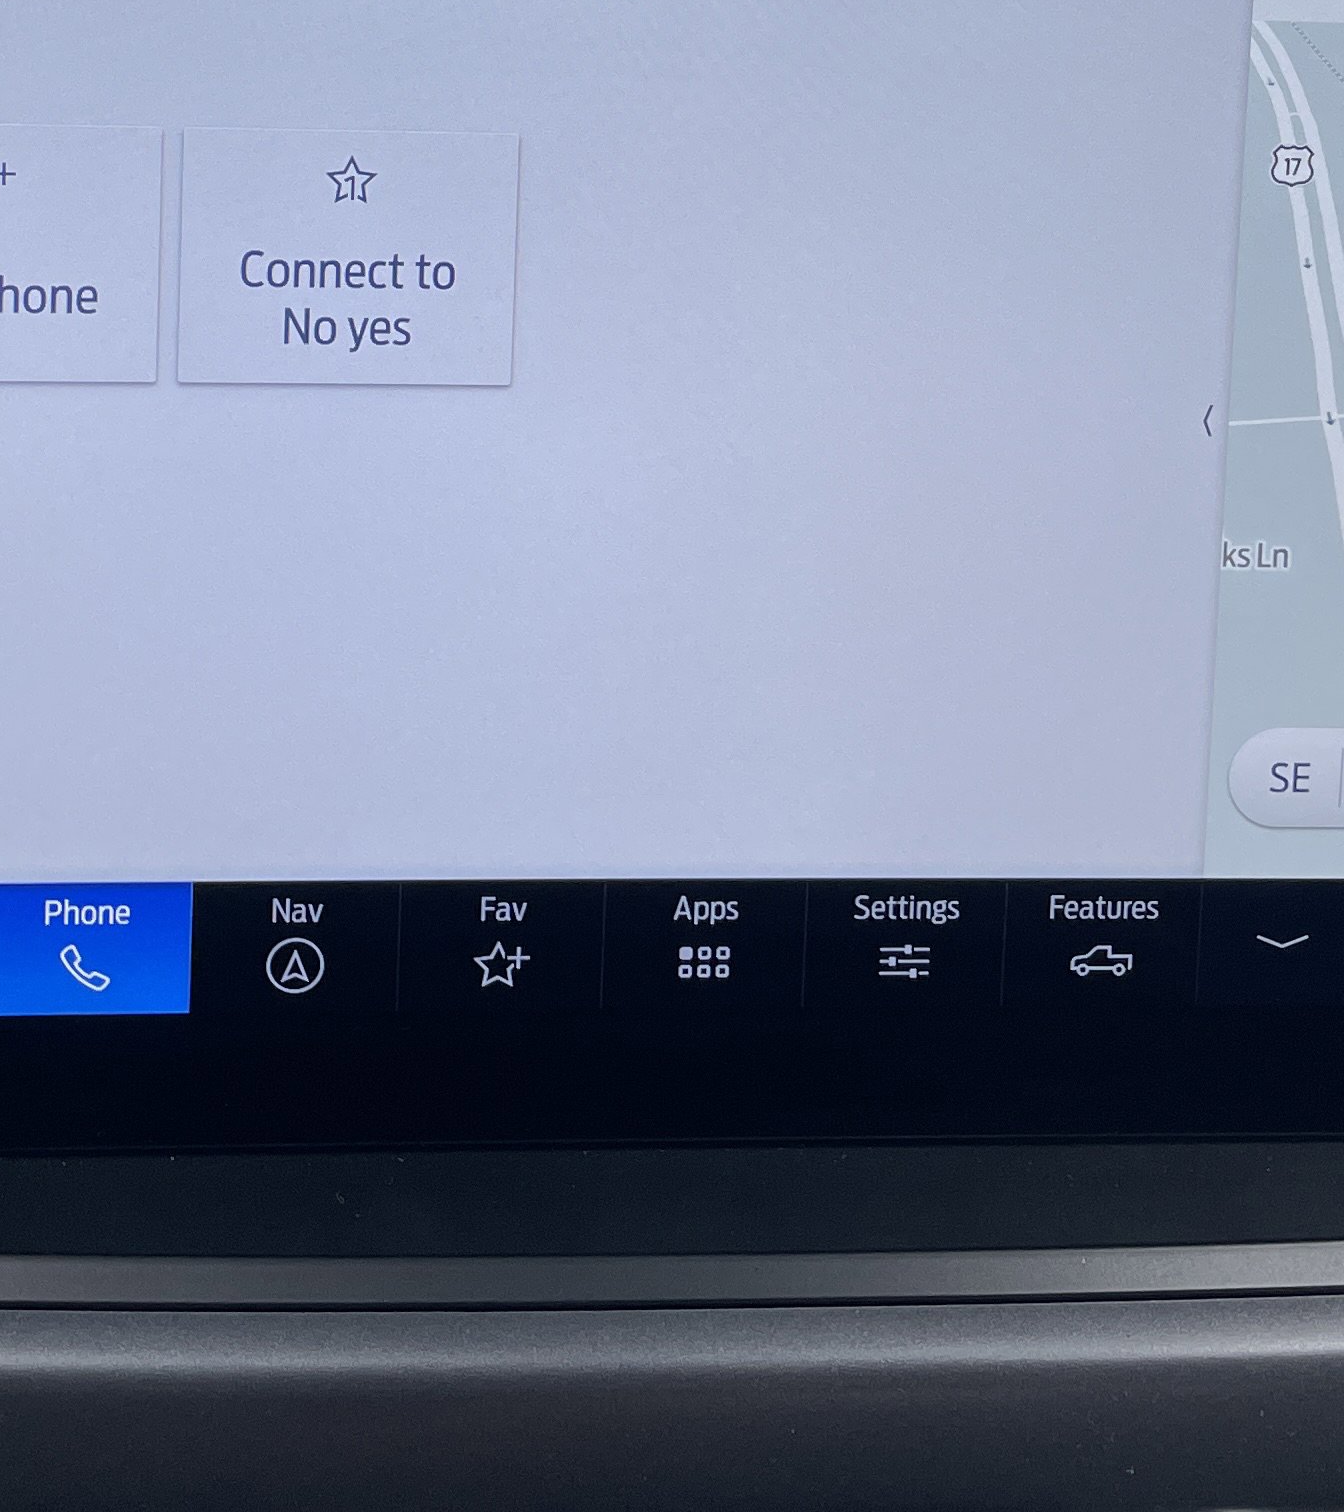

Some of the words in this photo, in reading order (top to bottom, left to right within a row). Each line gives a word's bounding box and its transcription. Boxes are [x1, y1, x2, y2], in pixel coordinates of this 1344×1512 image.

[1284, 157, 1302, 176] 17
[240, 250, 405, 290] Connect
[415, 254, 456, 290] to
[283, 307, 337, 345] No
[347, 317, 411, 353] yes
[1257, 542, 1289, 568] Ln
[1269, 762, 1311, 793] SE
[44, 898, 131, 926] Phone
[271, 897, 324, 924] Nav
[480, 896, 528, 922] Fav
[673, 895, 739, 926] Apps
[853, 894, 960, 925] Settings
[1049, 894, 1159, 920] Features
